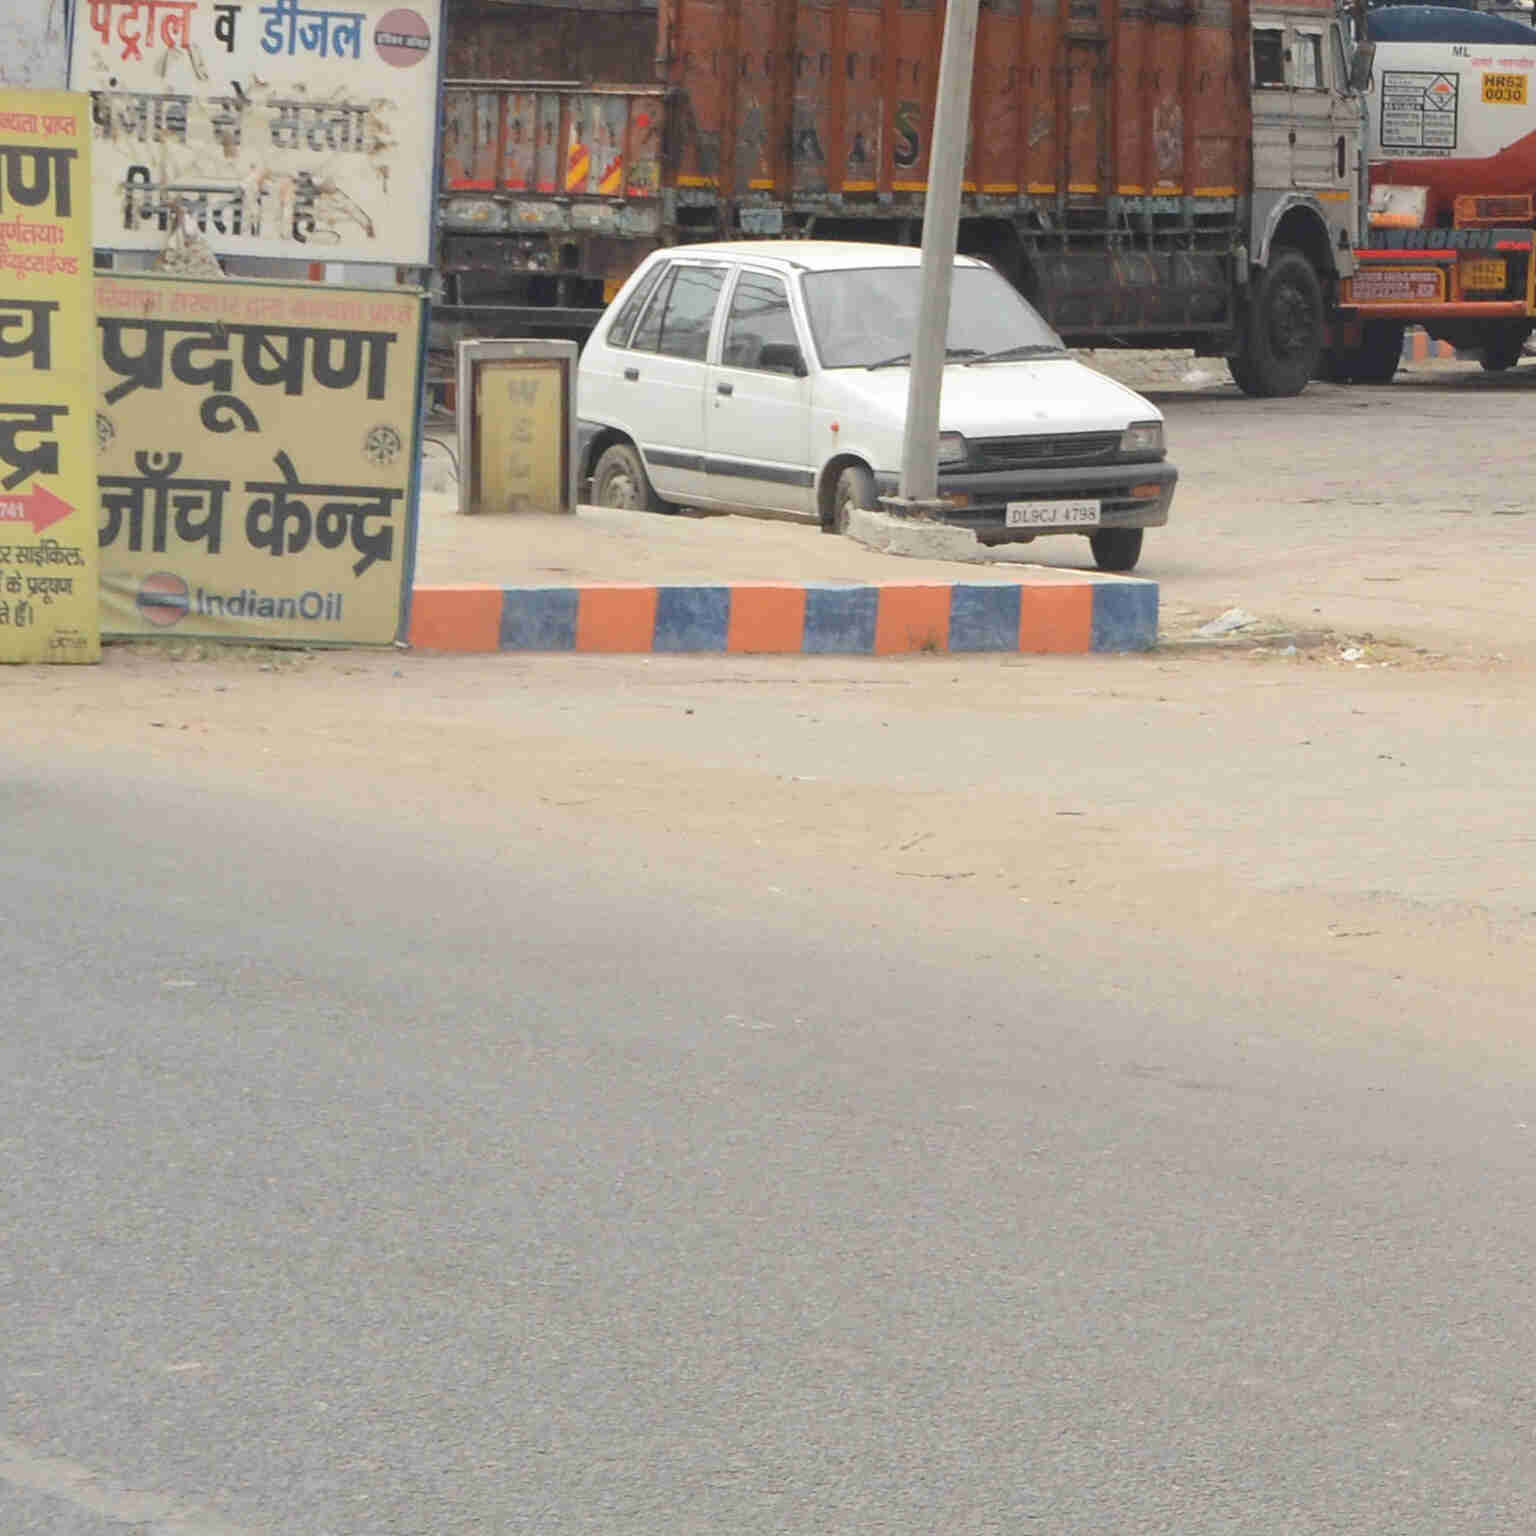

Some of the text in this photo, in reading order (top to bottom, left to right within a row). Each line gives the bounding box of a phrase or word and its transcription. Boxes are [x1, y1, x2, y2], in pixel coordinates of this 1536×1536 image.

[213, 3, 242, 54] व
[97, 317, 397, 434] प्रदूषण
[244, 450, 404, 577] केन्द्र
[196, 588, 343, 622] IndianOil
